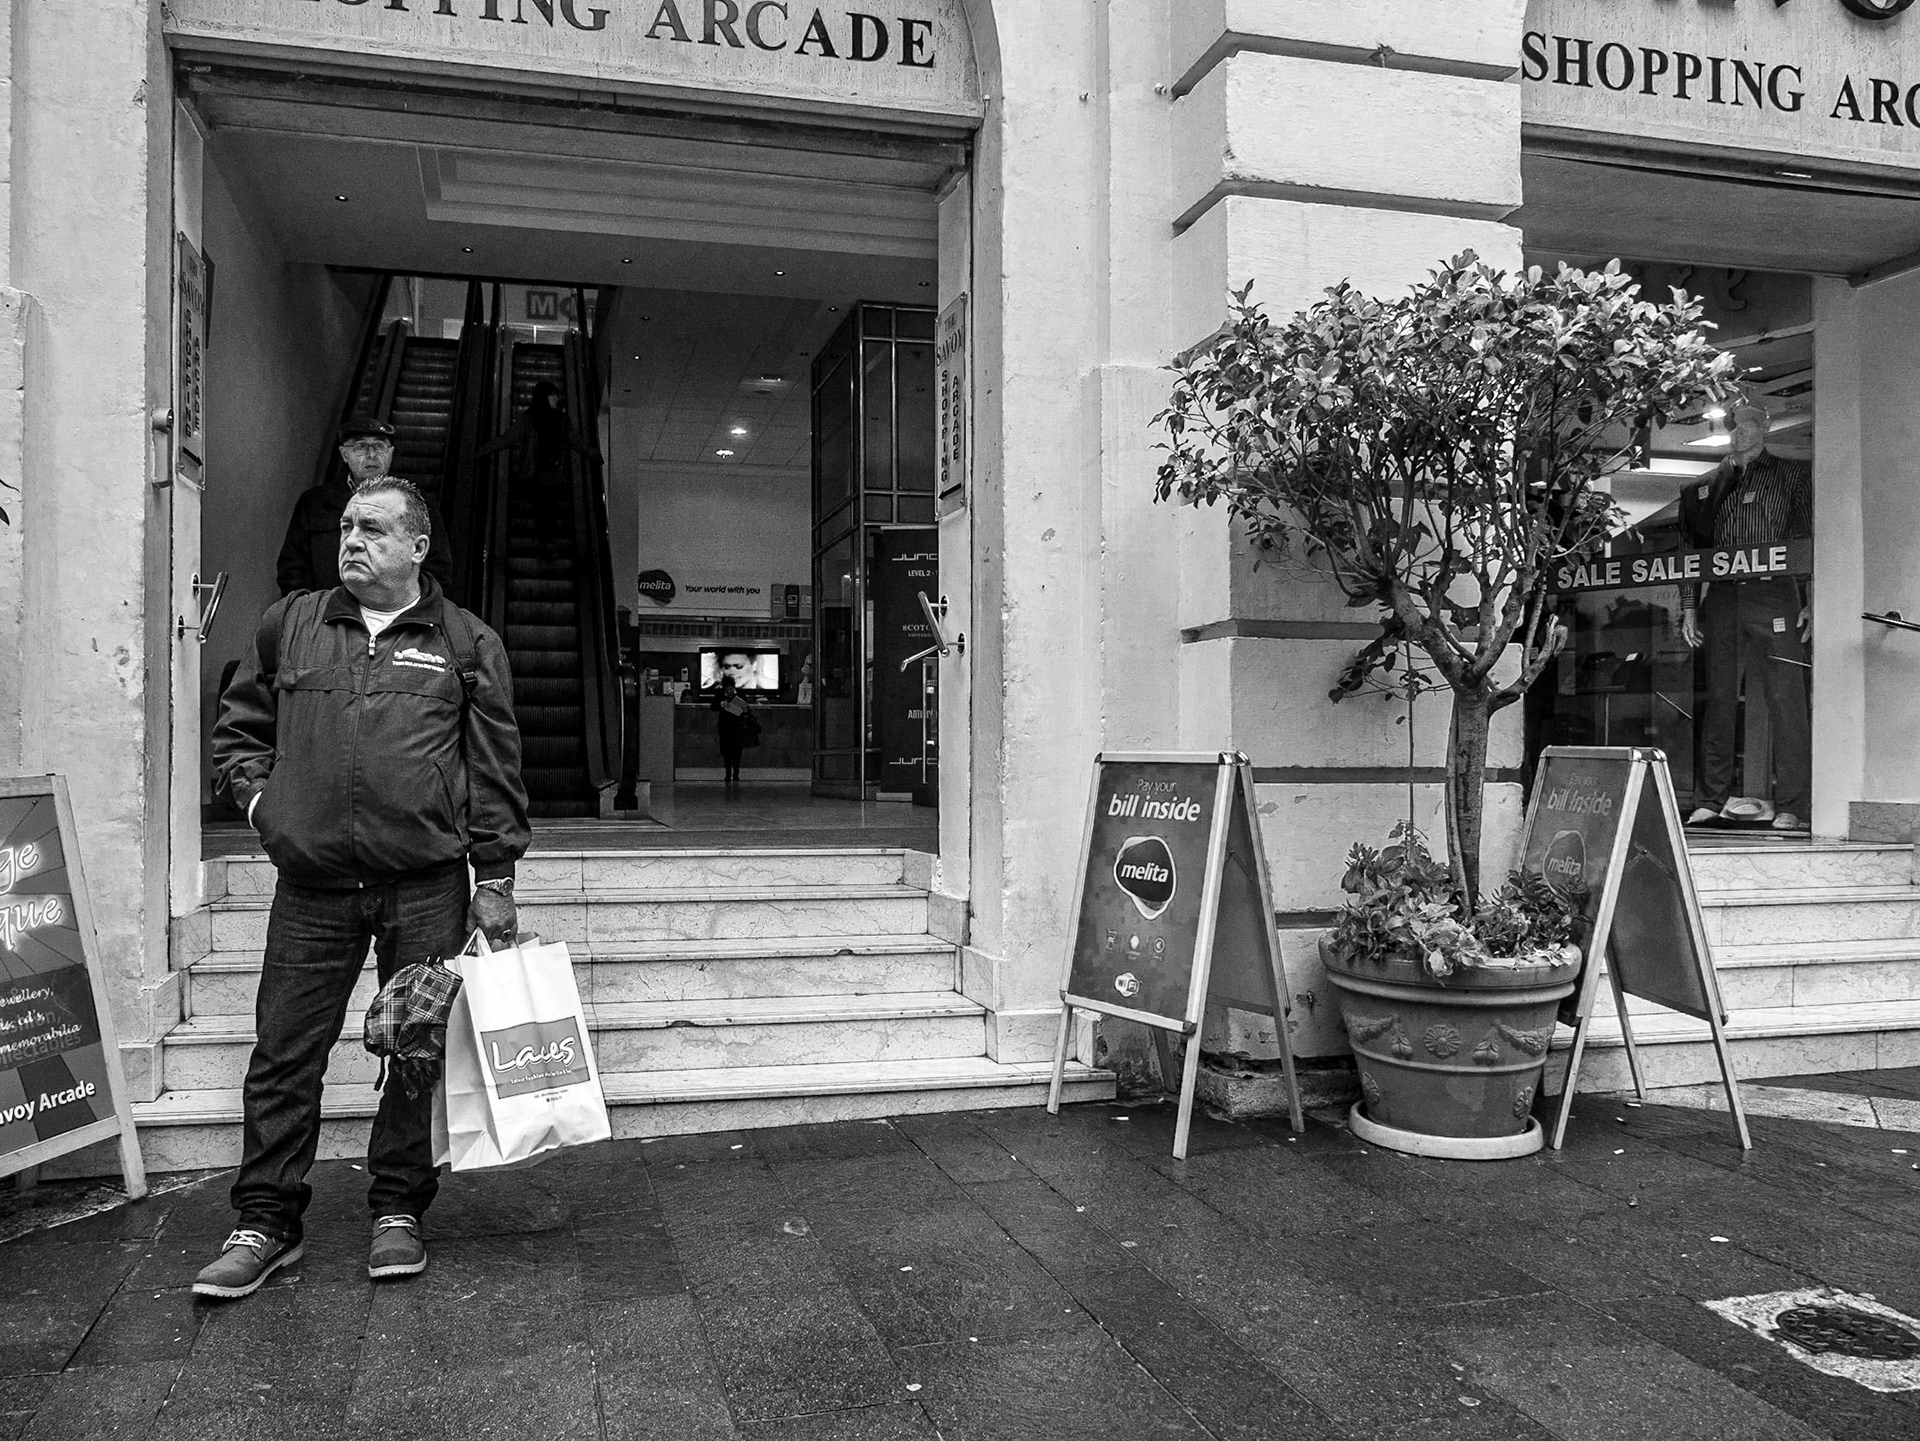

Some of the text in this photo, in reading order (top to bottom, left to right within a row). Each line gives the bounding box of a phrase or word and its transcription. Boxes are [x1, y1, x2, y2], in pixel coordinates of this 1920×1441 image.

[645, 0, 935, 69] ARCADE
[1521, 31, 1804, 112] SHOPPING
[944, 312, 956, 332] THE
[936, 326, 963, 368] SAVOY
[952, 375, 960, 461] ARCADE
[1557, 546, 1787, 589] SALE SALE SALE
[639, 580, 672, 591] melita
[685, 585, 760, 596] Your world with you
[1137, 778, 1177, 795] Pay your
[1108, 793, 1201, 822] bill inside
[1546, 788, 1612, 816] bill inside
[1121, 862, 1169, 883] melita
[1547, 855, 1581, 876] melita
[0, 1079, 96, 1125] voy Arcade
